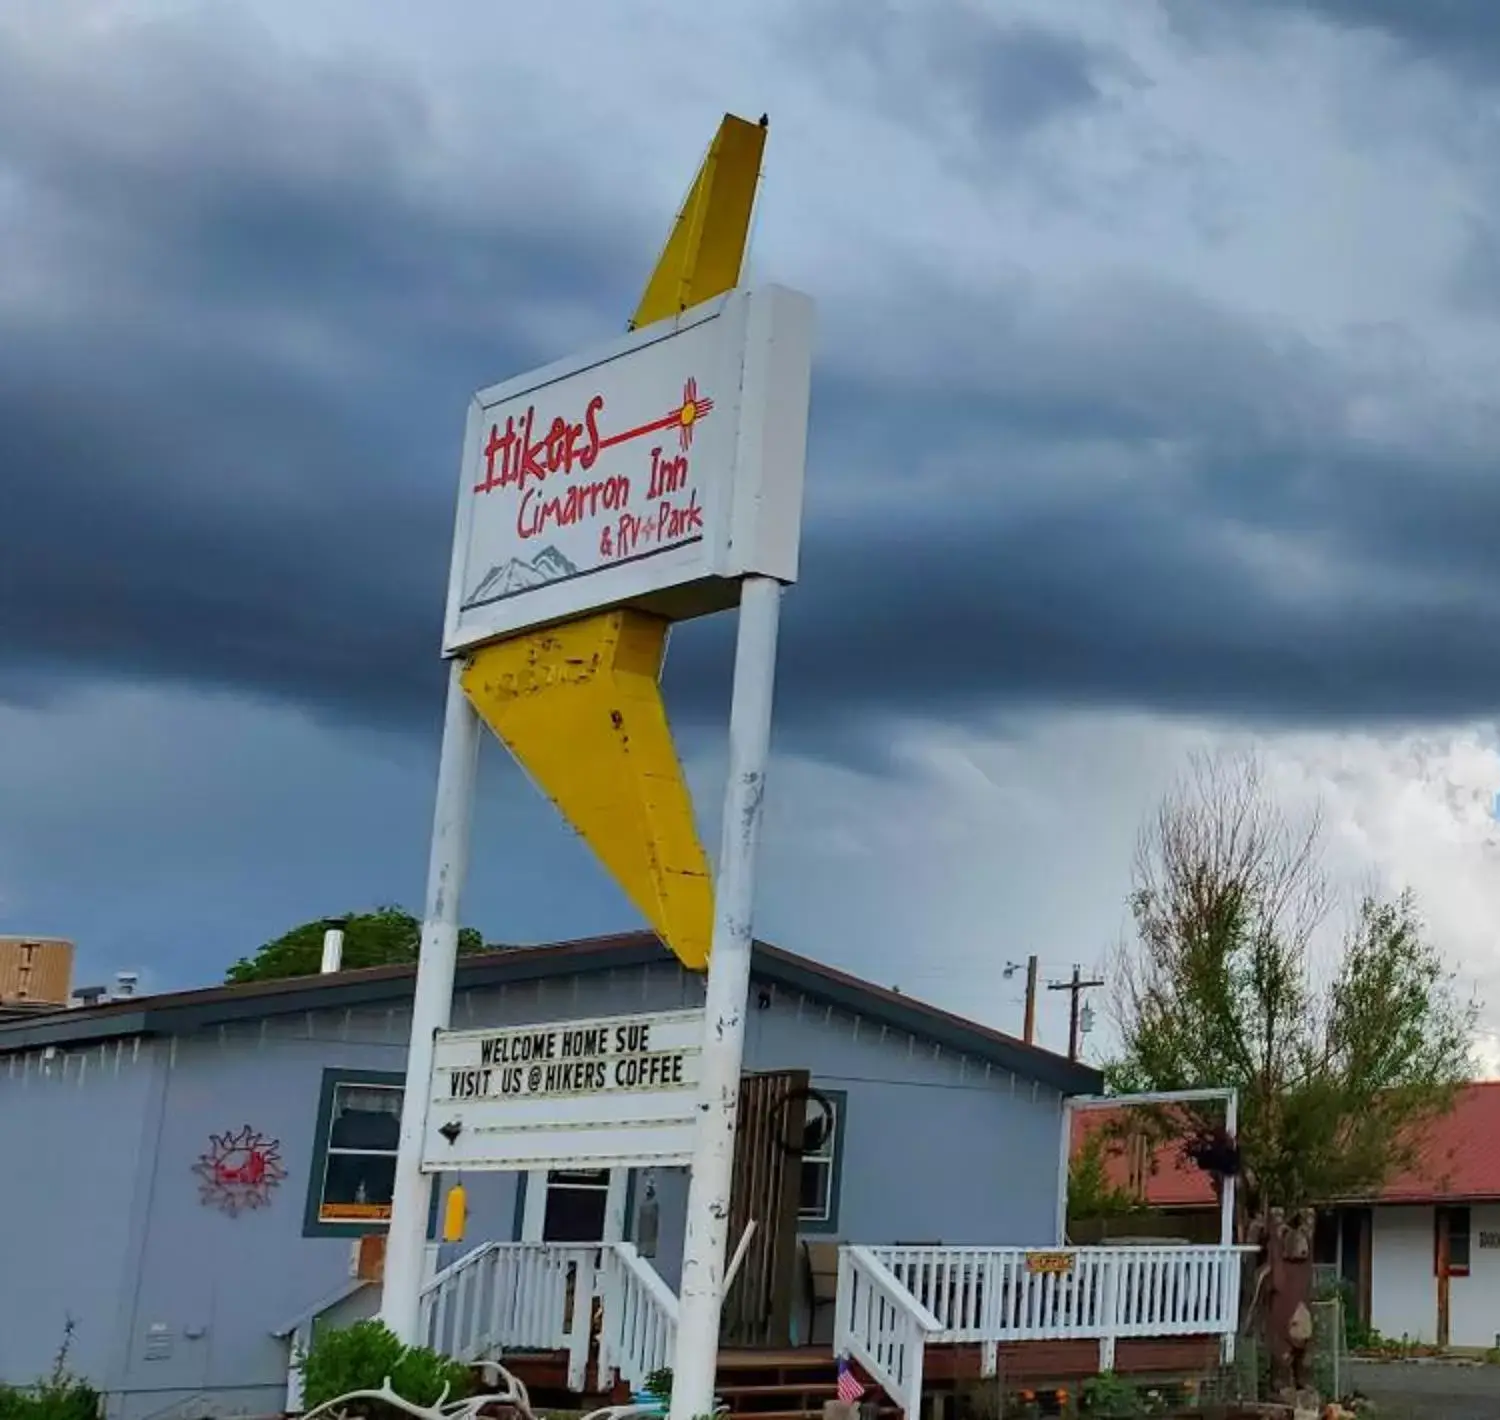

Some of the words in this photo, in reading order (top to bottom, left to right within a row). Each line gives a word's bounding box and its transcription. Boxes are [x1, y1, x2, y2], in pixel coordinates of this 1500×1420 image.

[517, 475, 630, 539] Cimarron
[647, 447, 688, 499] Inn
[601, 525, 613, 556] &
[481, 1033, 556, 1065] WELCOME
[562, 1028, 608, 1057] HOME
[615, 1024, 649, 1053] SUE
[451, 1069, 492, 1097] VISIT
[501, 1067, 522, 1093] US
[545, 1062, 606, 1092] HIKERS
[615, 1056, 682, 1086] COFFEE
